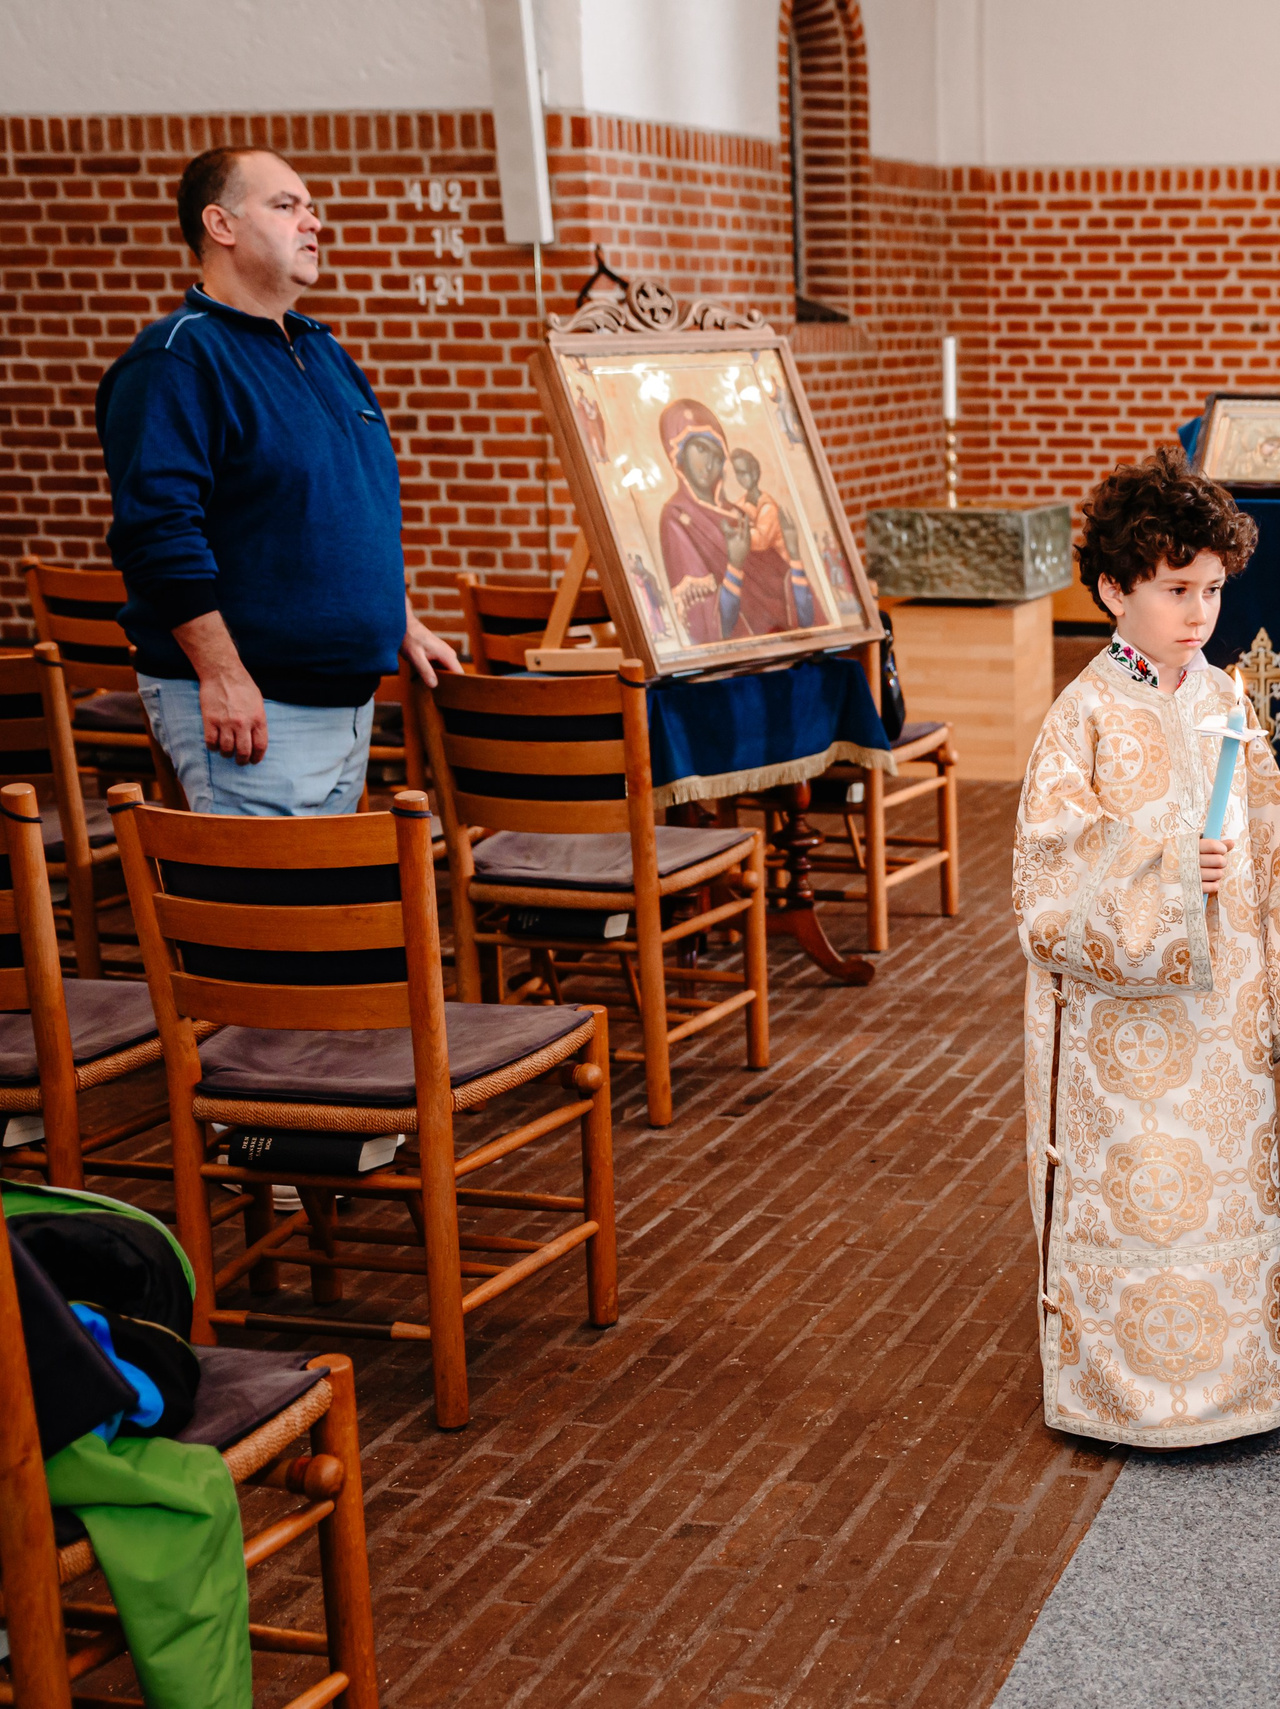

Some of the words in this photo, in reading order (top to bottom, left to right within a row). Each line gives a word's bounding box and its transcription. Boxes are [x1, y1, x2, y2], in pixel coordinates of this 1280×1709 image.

[409, 180, 463, 212] 402
[431, 227, 465, 259] 15
[415, 275, 465, 306] 121
[241, 1136, 250, 1149] DEN
